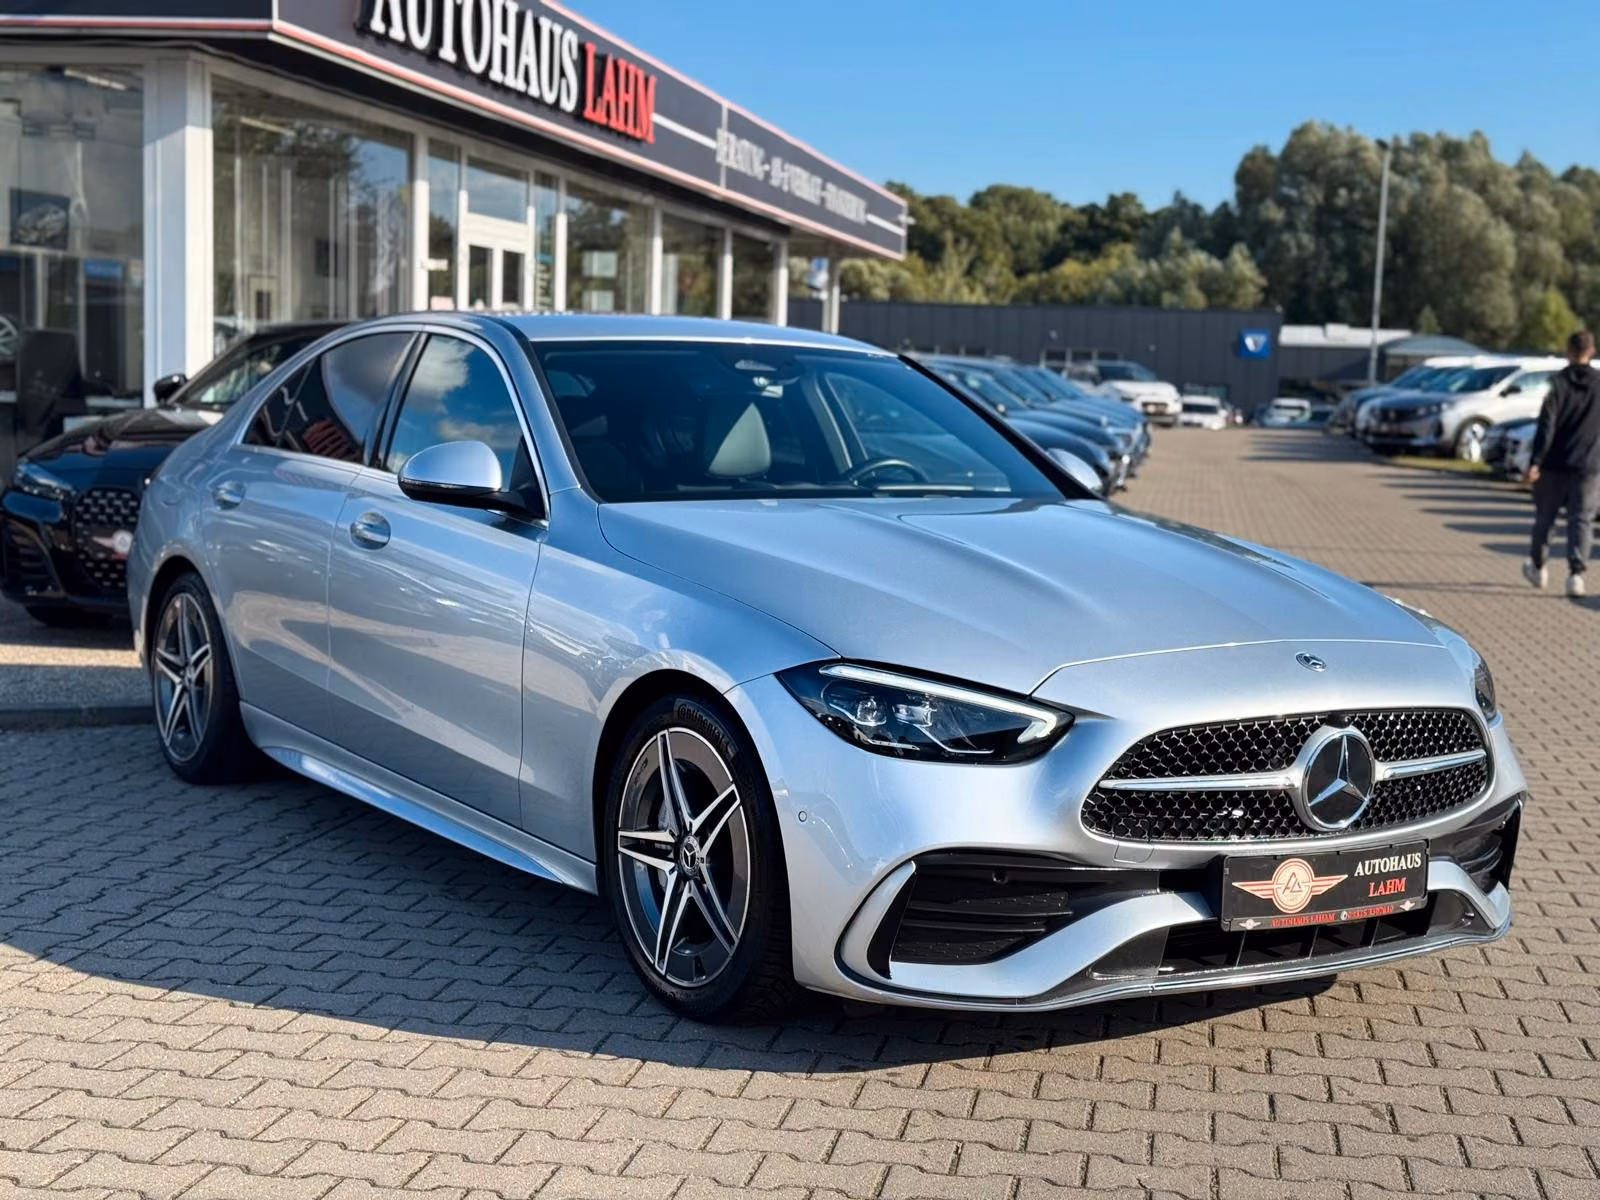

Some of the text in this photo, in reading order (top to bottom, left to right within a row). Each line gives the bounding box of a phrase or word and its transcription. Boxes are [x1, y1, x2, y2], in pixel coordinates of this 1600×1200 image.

[583, 42, 656, 144] LAHM
[1354, 853, 1422, 876] AUTOHAUS
[1368, 877, 1407, 897] LAHM
